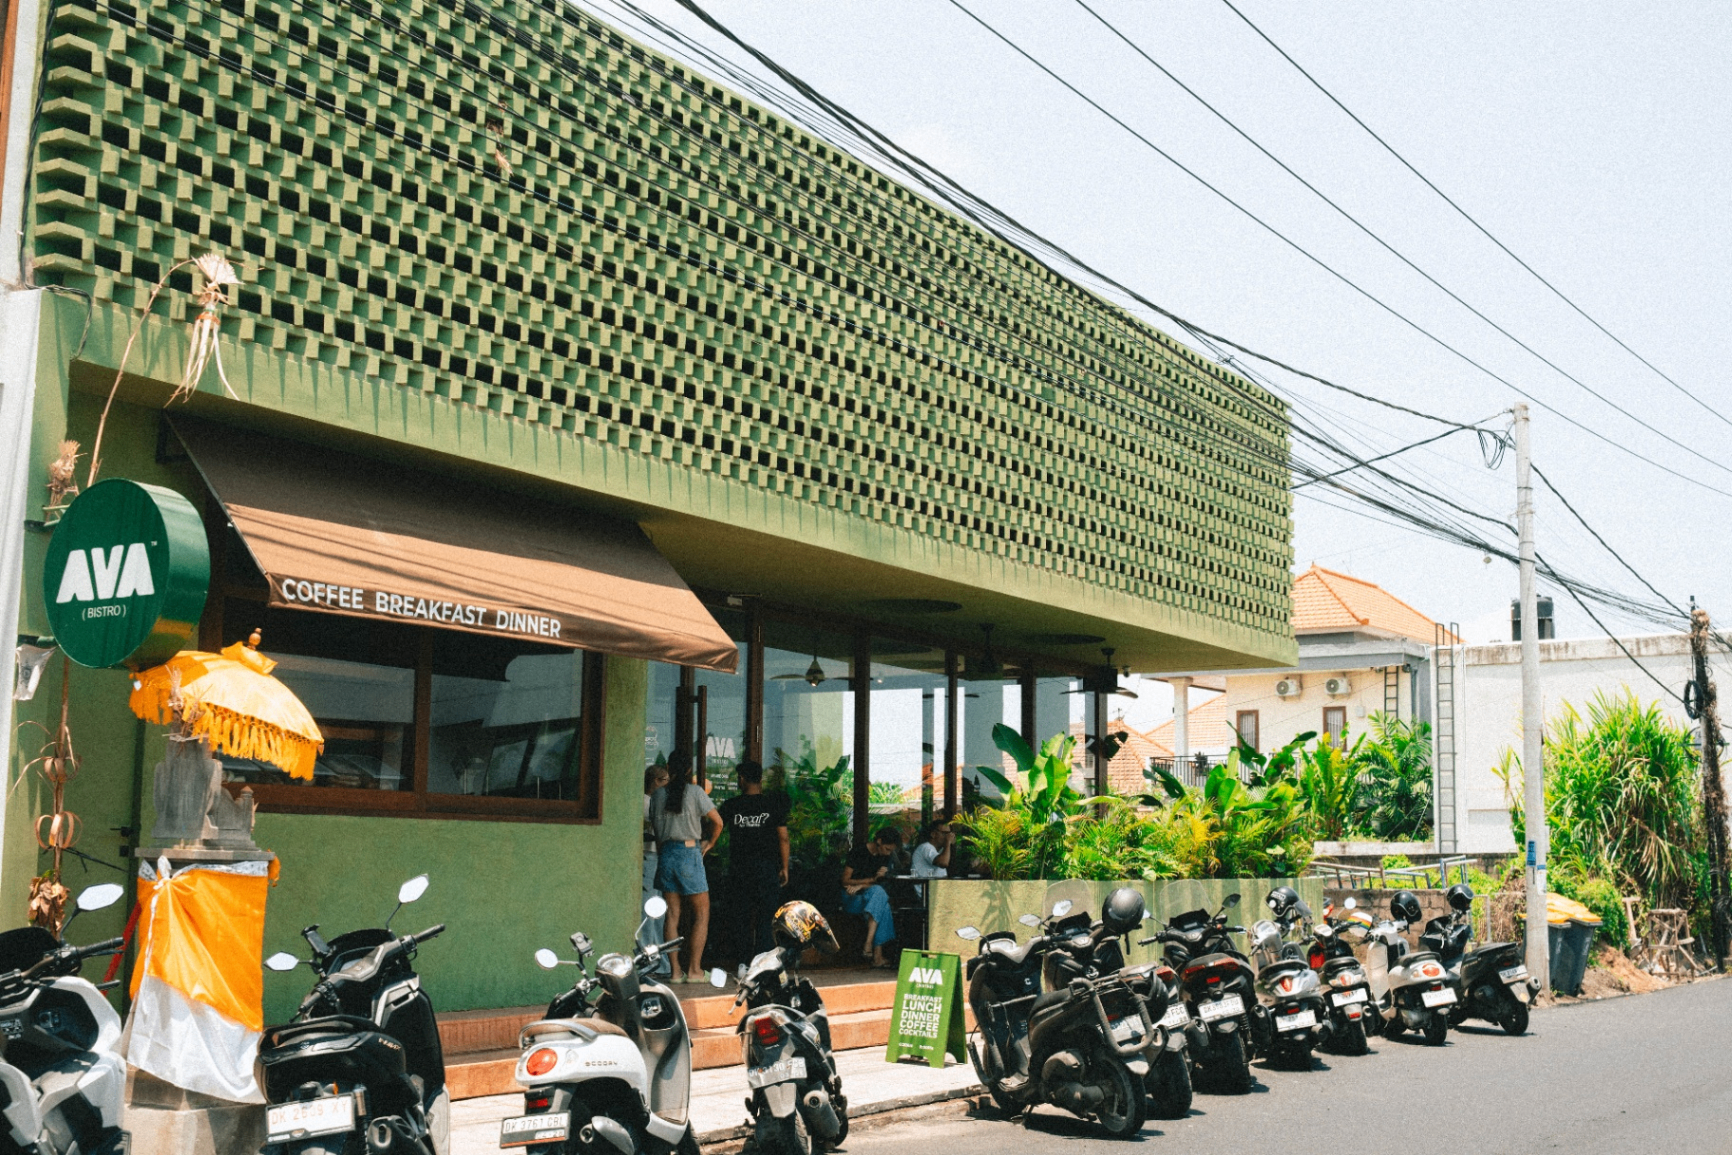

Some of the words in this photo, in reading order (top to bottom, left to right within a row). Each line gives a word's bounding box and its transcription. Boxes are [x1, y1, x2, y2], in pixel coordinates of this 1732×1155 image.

[56, 543, 154, 603] AVA
[282, 578, 364, 609] COFFEE
[375, 591, 487, 626] BREAKFAST
[496, 609, 561, 638] DINNER
[706, 736, 736, 758] AVA
[734, 812, 770, 825] Decaf?
[908, 967, 943, 985] AVA
[904, 993, 942, 1003] BREAKFAST
[902, 1000, 942, 1013] LUNCH
[901, 1010, 940, 1022] DINNER
[900, 1019, 939, 1032] COFFEE
[899, 1028, 938, 1038] COCKTAILS
[271, 1111, 287, 1125] DK
[331, 1100, 349, 1114] XY
[505, 1121, 516, 1132] DK
[520, 1118, 544, 1130] 3761
